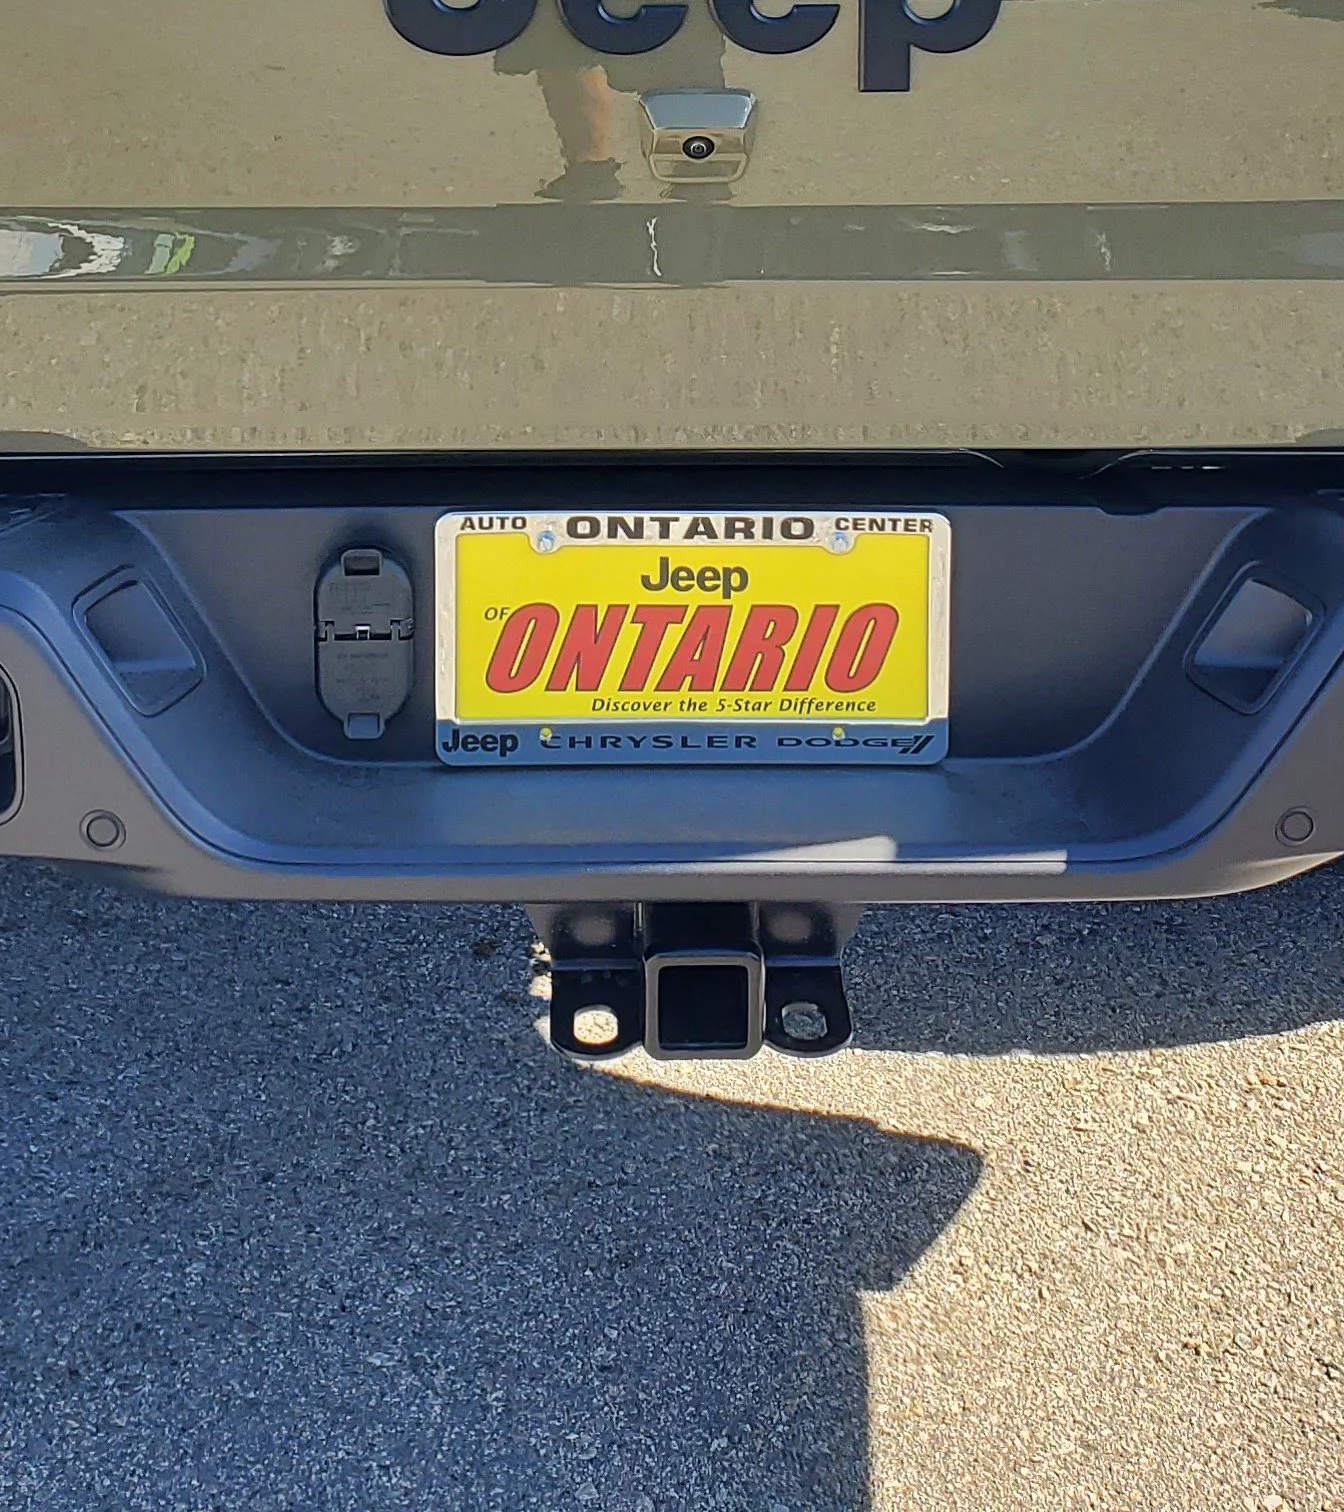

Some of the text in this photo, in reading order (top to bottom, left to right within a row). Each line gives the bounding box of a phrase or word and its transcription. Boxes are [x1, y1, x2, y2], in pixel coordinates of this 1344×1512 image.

[460, 516, 934, 540] AUTO ONTARIO CENTER
[640, 556, 749, 599] Jeep
[484, 602, 900, 694] OF ONTARIO
[592, 698, 877, 714] Discover the 5-Star Difference
[442, 728, 916, 757] Jeep CHRYSLER DODGE
